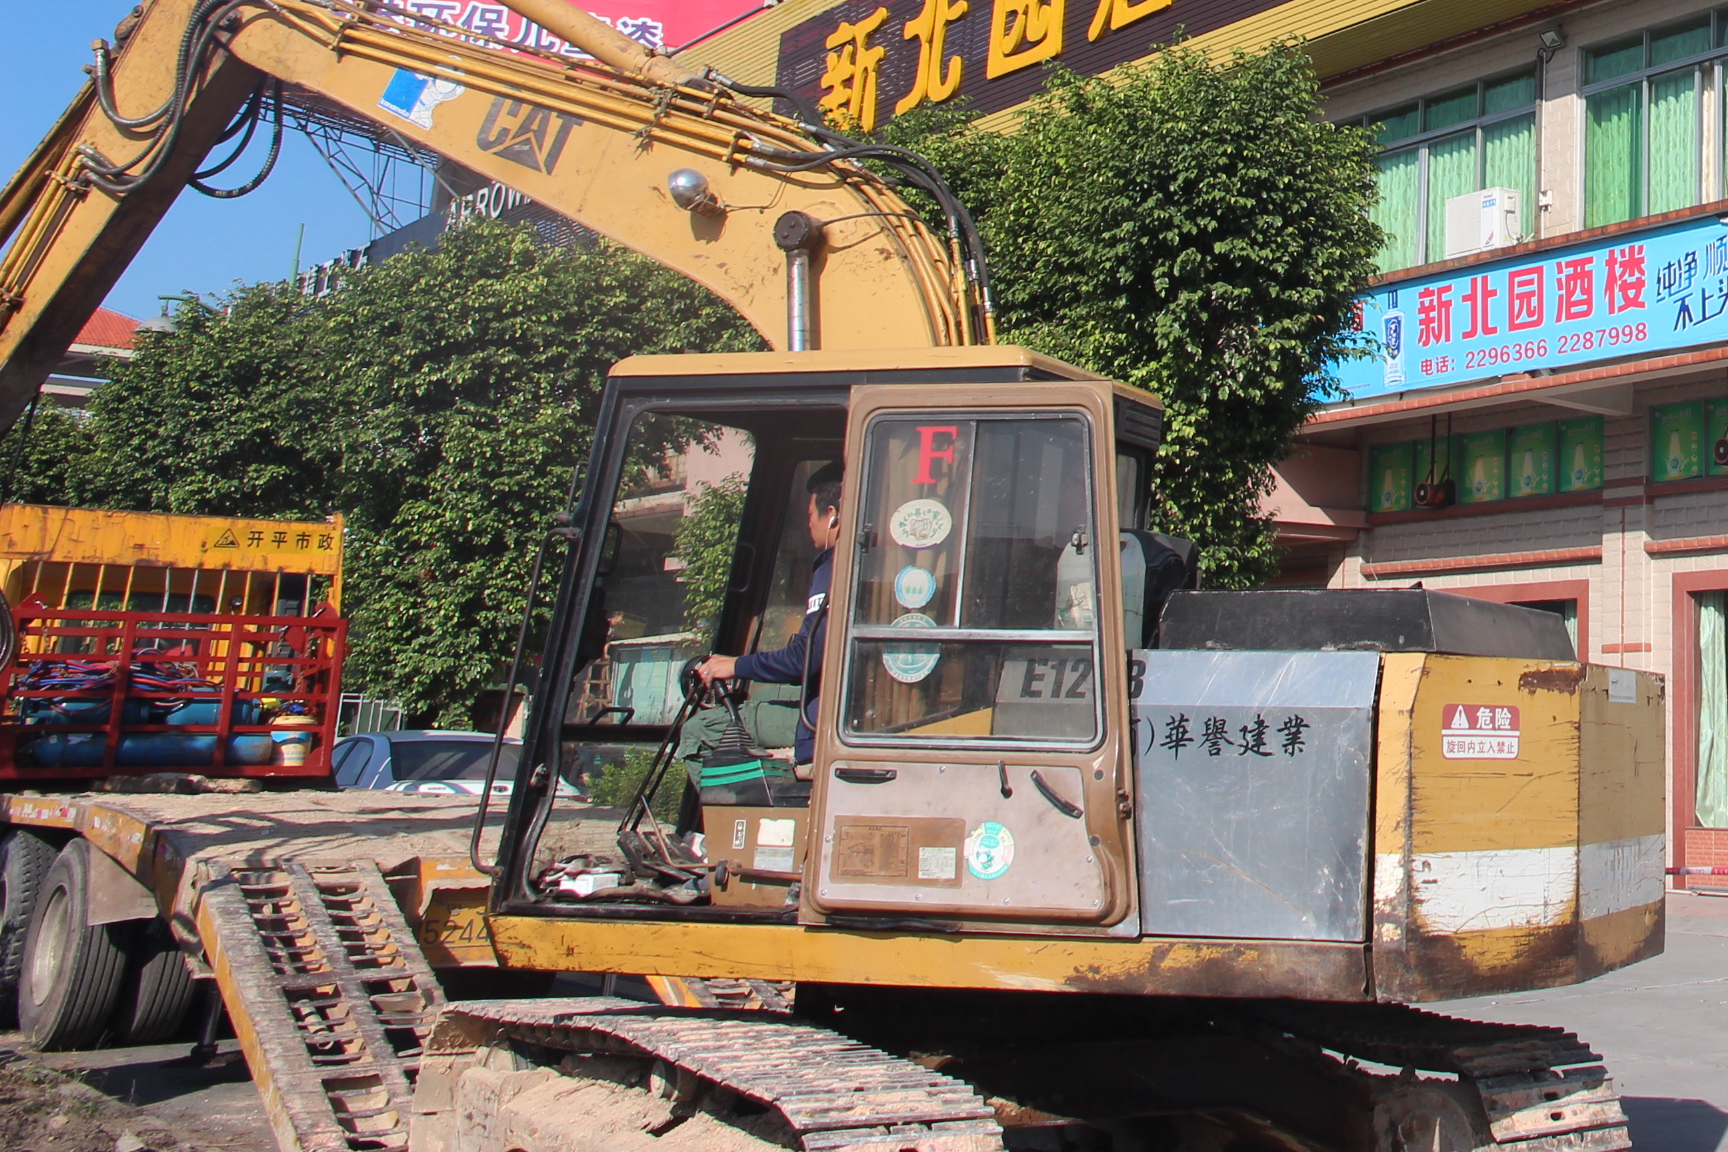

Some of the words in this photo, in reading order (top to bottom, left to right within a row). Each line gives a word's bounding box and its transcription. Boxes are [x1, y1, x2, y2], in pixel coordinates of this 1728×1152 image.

[476, 94, 586, 177] CAT
[1416, 243, 1649, 349] 新北园酒楼
[1655, 248, 1700, 304] 纯净
[1464, 337, 1549, 371] 2296366
[1556, 321, 1649, 356] 2287998
[911, 425, 960, 485] F
[246, 530, 335, 552] 开平市政
[1475, 706, 1512, 730] 危险
[1445, 739, 1516, 755] 旋回内立入禁止
